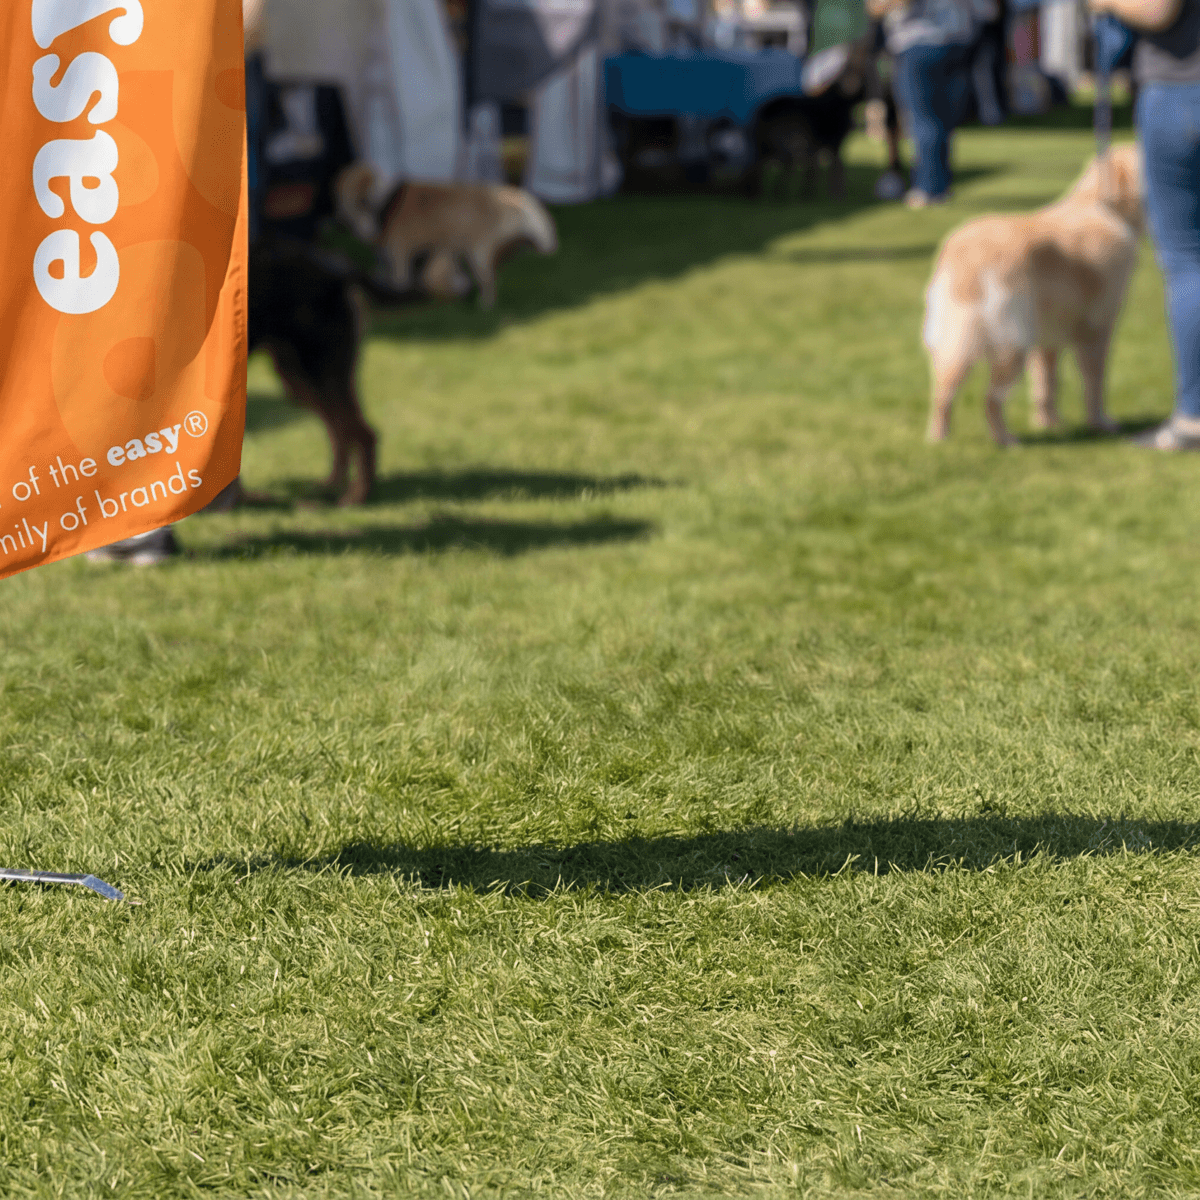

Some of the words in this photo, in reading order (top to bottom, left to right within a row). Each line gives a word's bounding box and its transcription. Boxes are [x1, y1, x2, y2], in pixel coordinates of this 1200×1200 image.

[12, 466, 40, 501] of
[49, 455, 98, 488] the
[59, 496, 88, 531] of
[94, 461, 203, 519] brands
